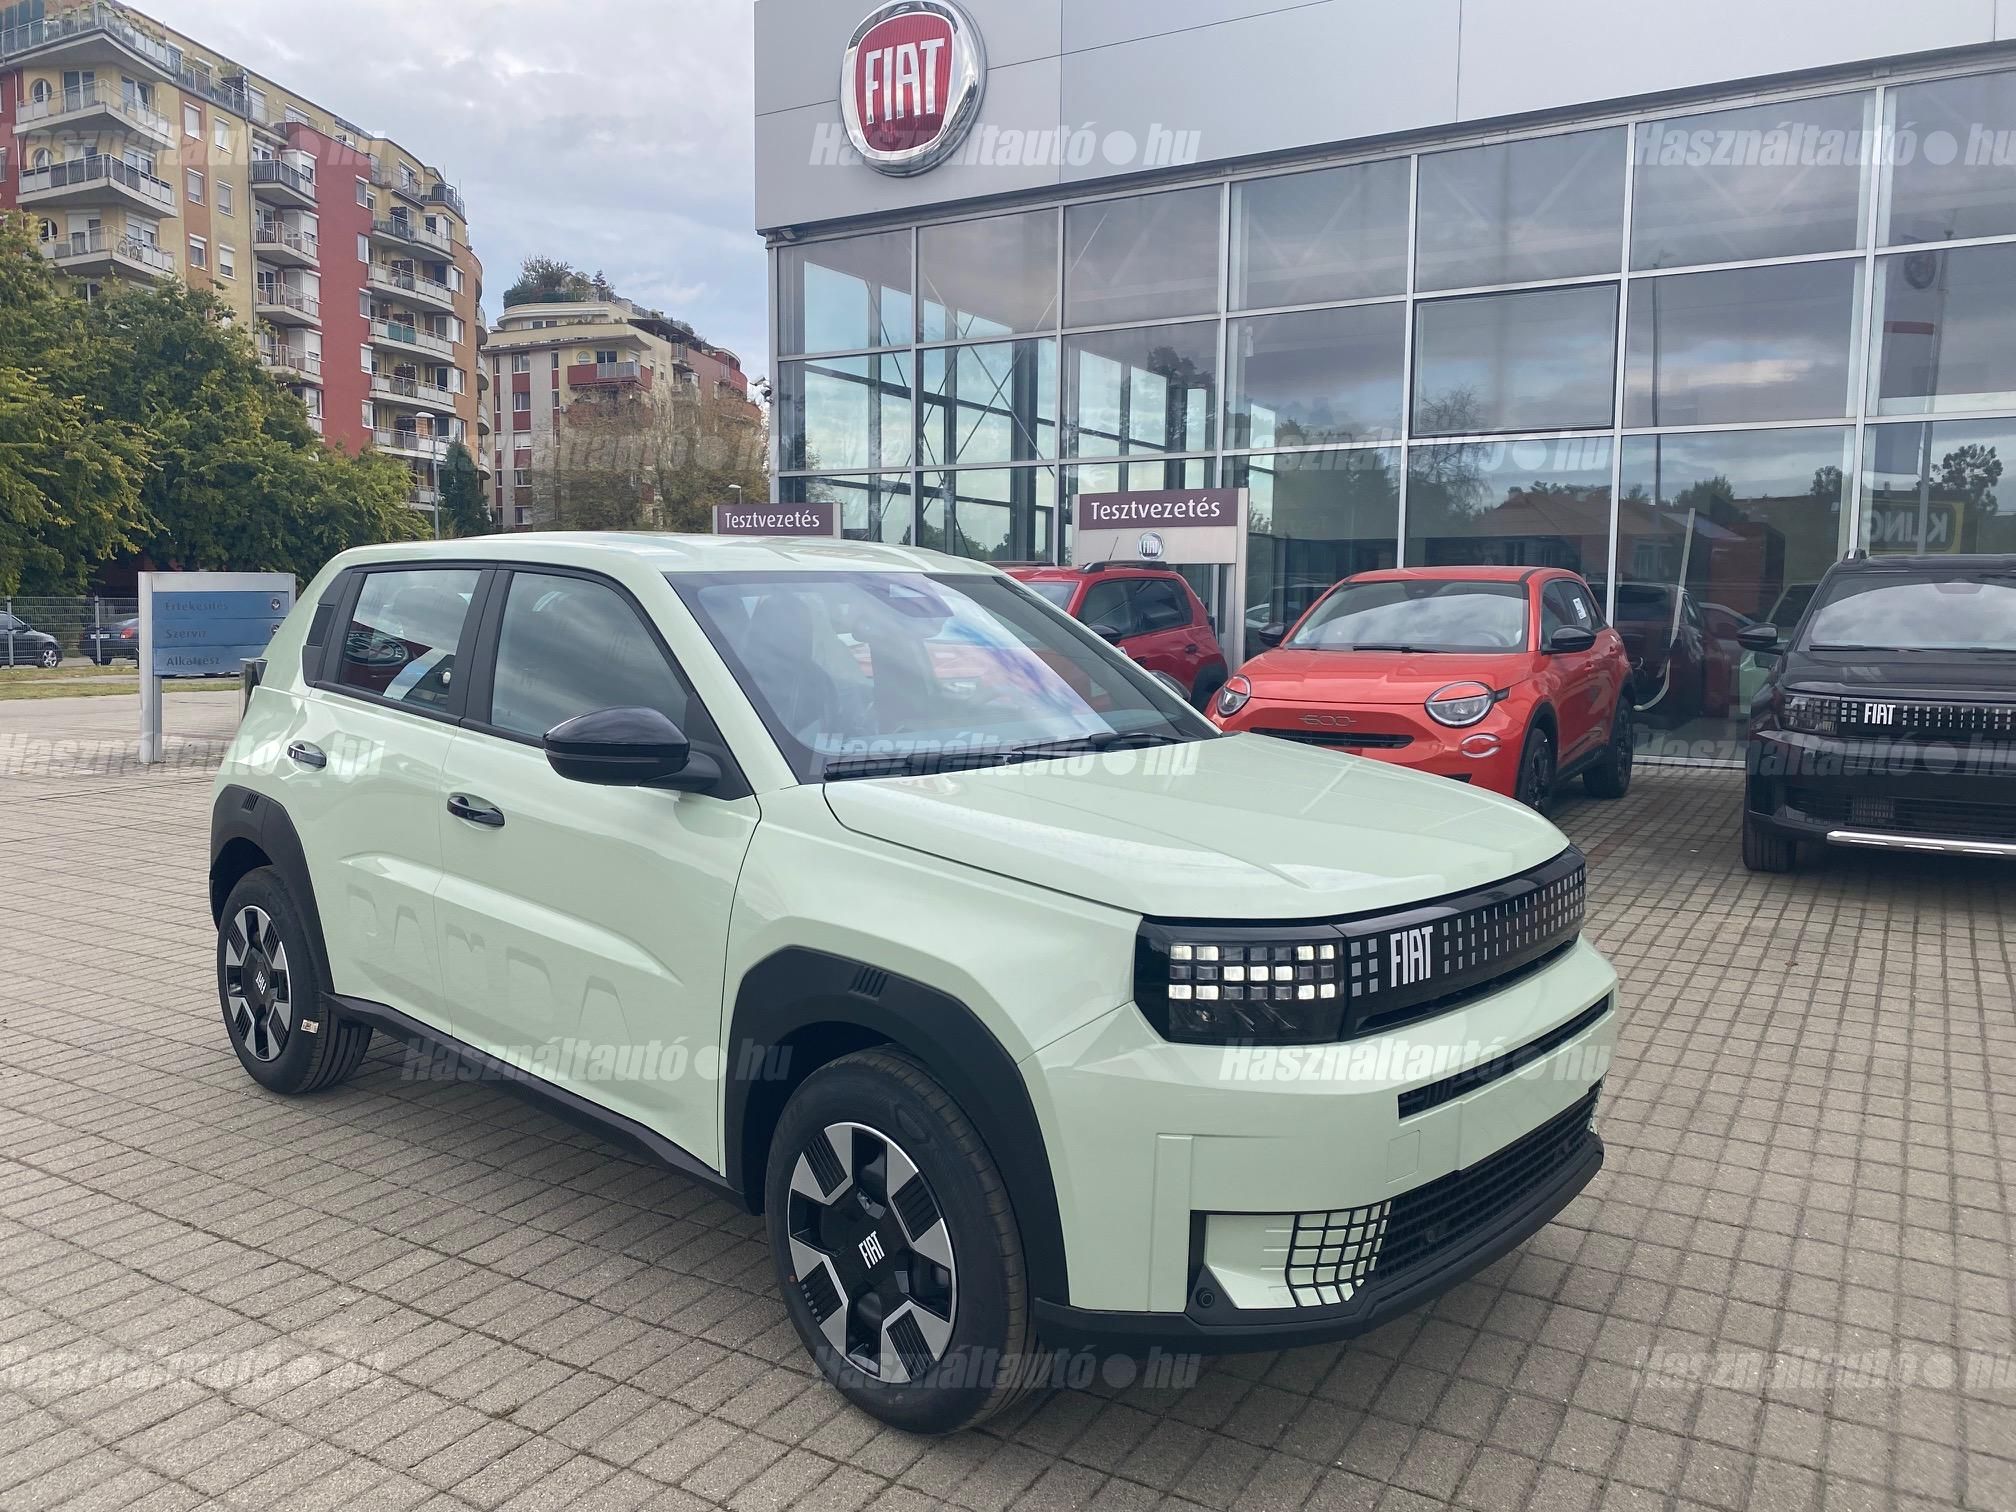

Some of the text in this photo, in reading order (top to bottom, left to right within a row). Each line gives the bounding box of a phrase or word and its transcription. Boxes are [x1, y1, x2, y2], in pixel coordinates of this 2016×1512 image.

[866, 38, 945, 125] FIAT
[725, 510, 820, 528] Tesztvezetés
[1091, 497, 1220, 520] Tesztvezetés
[1143, 540, 1159, 553] FIAT
[1864, 703, 1896, 725] FIAT
[1390, 926, 1433, 987] FIAT
[858, 1230, 885, 1269] FIAT
